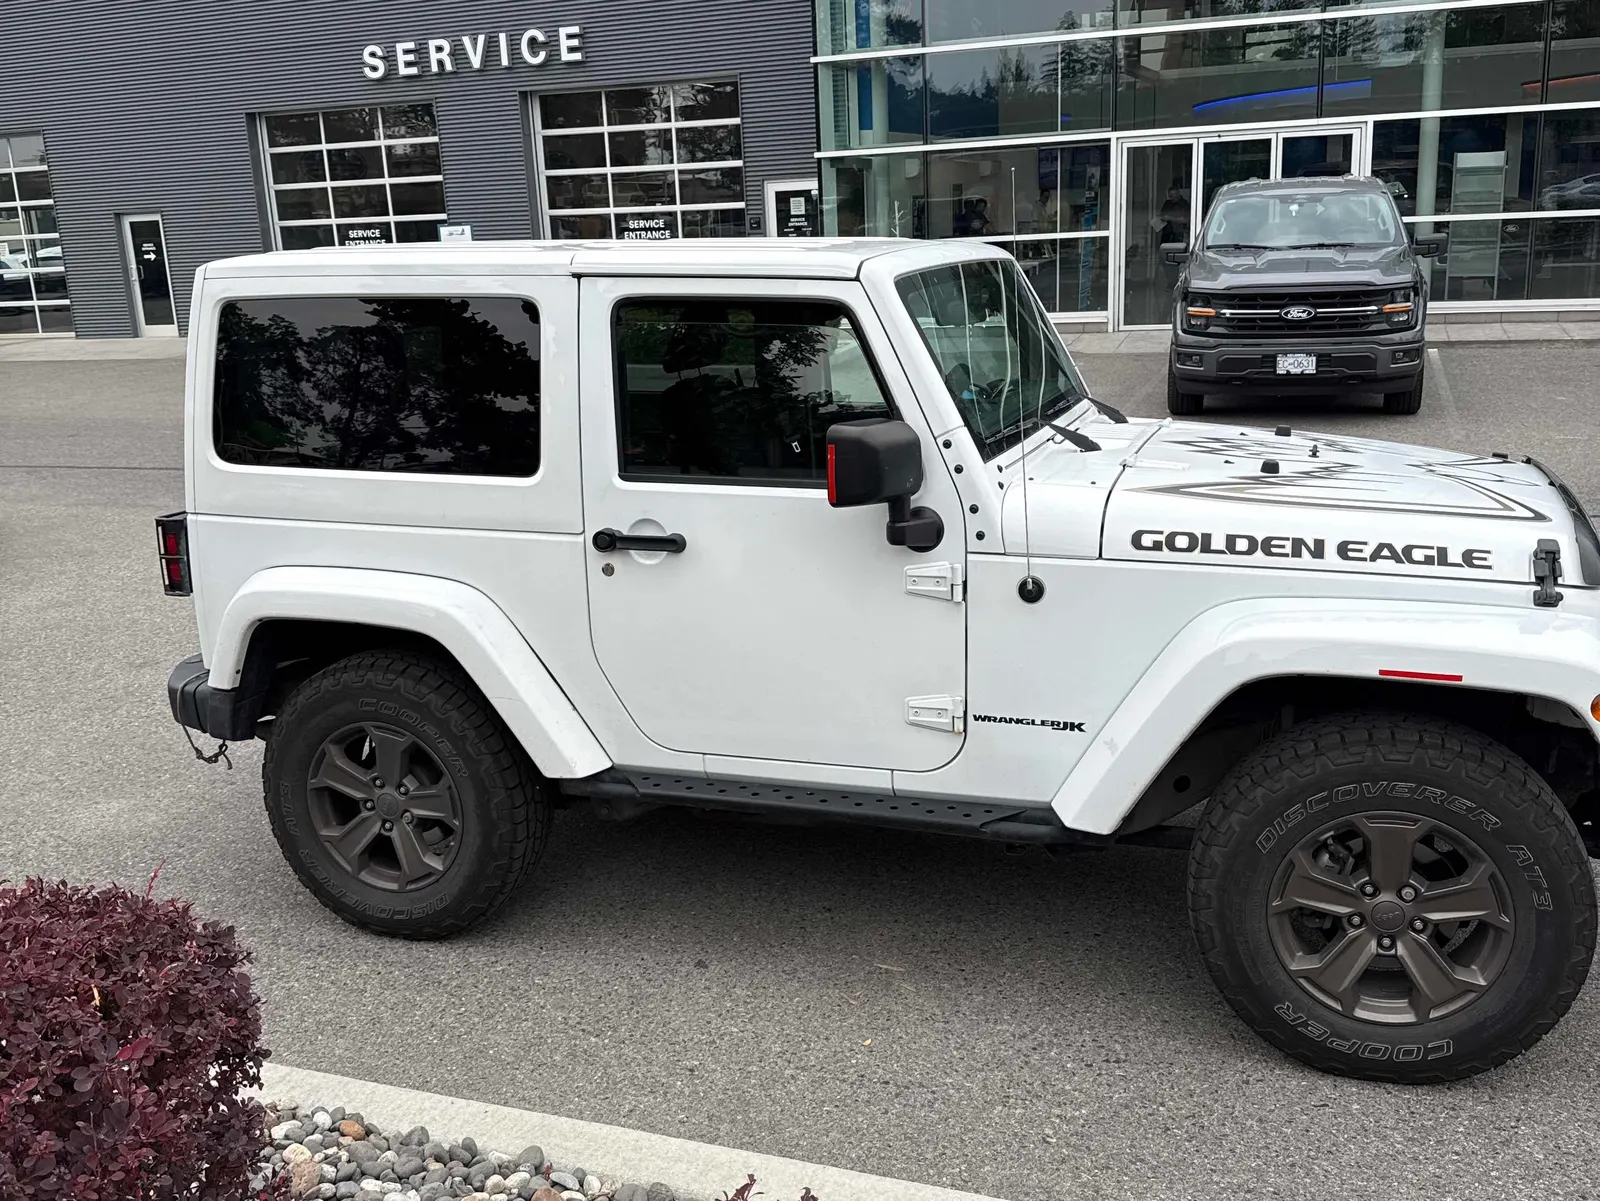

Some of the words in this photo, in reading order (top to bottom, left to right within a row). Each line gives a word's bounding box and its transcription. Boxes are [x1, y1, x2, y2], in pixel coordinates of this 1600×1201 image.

[362, 25, 583, 80] SERVICE
[348, 229, 381, 238] SERVICE
[624, 230, 671, 240] ENTRANCE
[628, 219, 665, 229] SERVICE
[1287, 308, 1309, 318] Ford
[1130, 529, 1326, 560] GOLDEN
[1336, 540, 1494, 570] EAGLE
[359, 698, 469, 777] COOPER
[1255, 781, 1502, 854] DISCOVERER
[1274, 1001, 1453, 1063] COOPER
